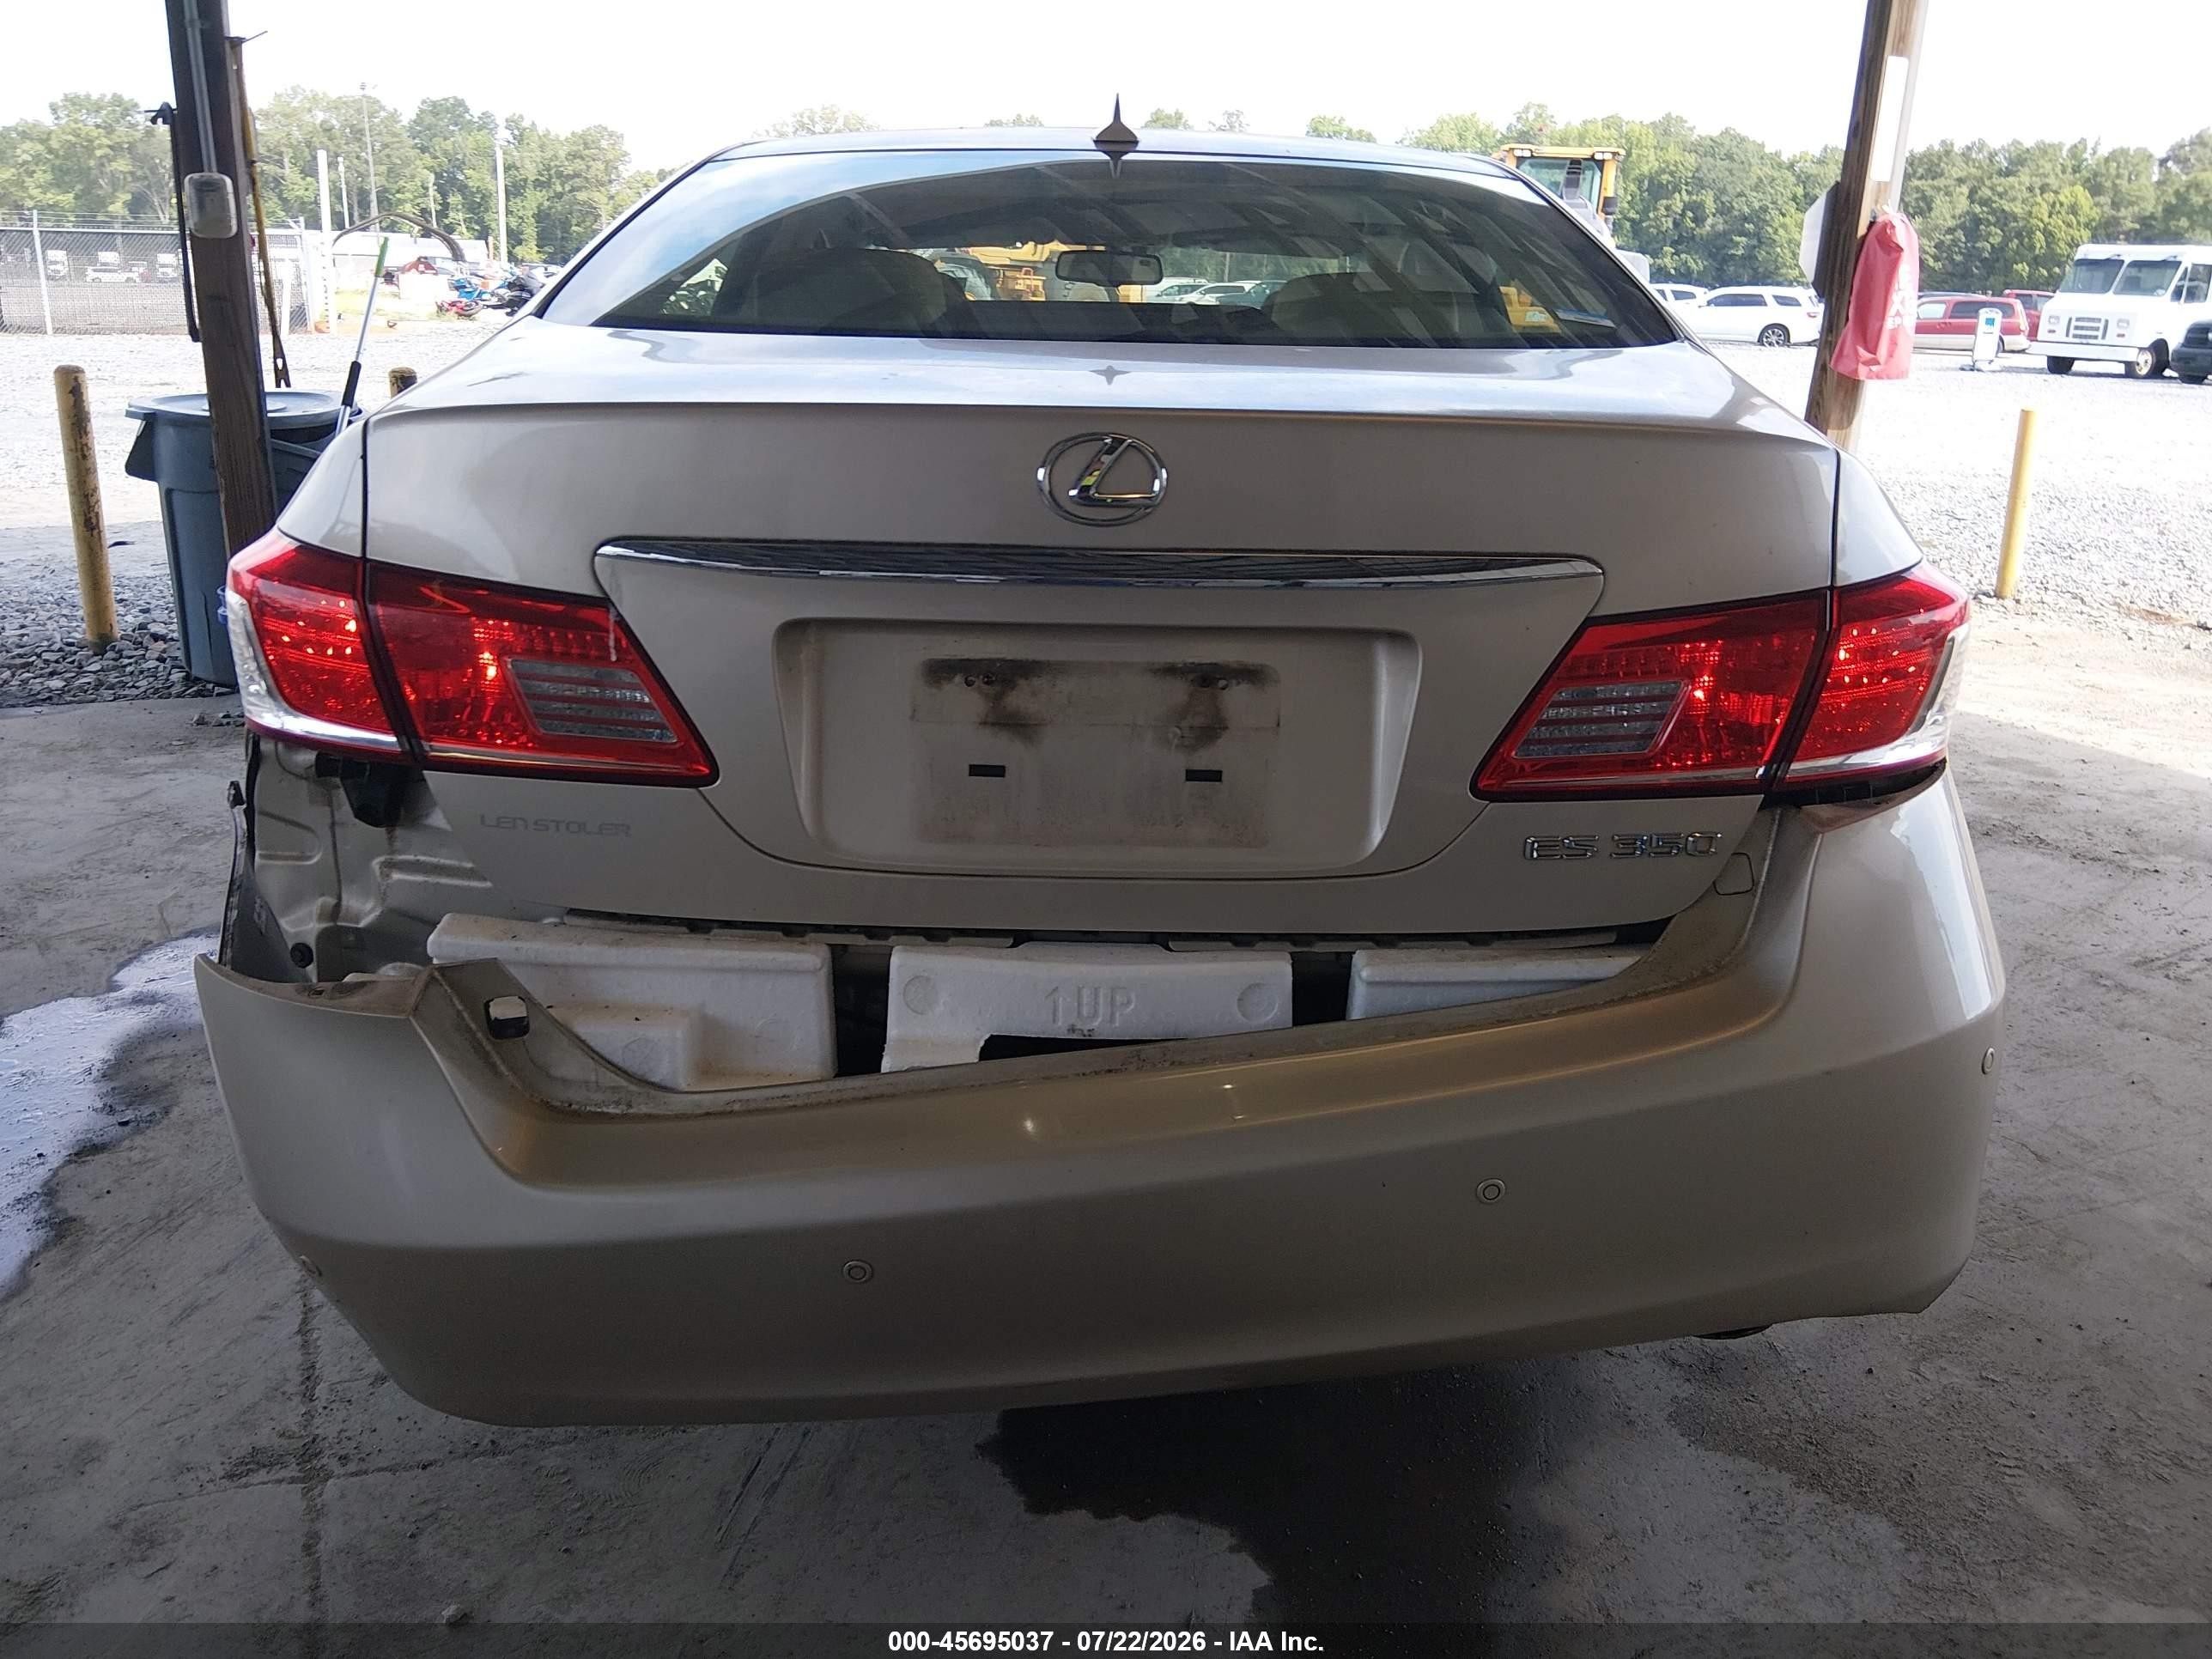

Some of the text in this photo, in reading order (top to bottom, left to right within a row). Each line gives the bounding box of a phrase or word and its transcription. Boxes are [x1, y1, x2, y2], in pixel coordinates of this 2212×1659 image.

[532, 818, 632, 838] STOLER
[1523, 831, 1722, 860] ES 350
